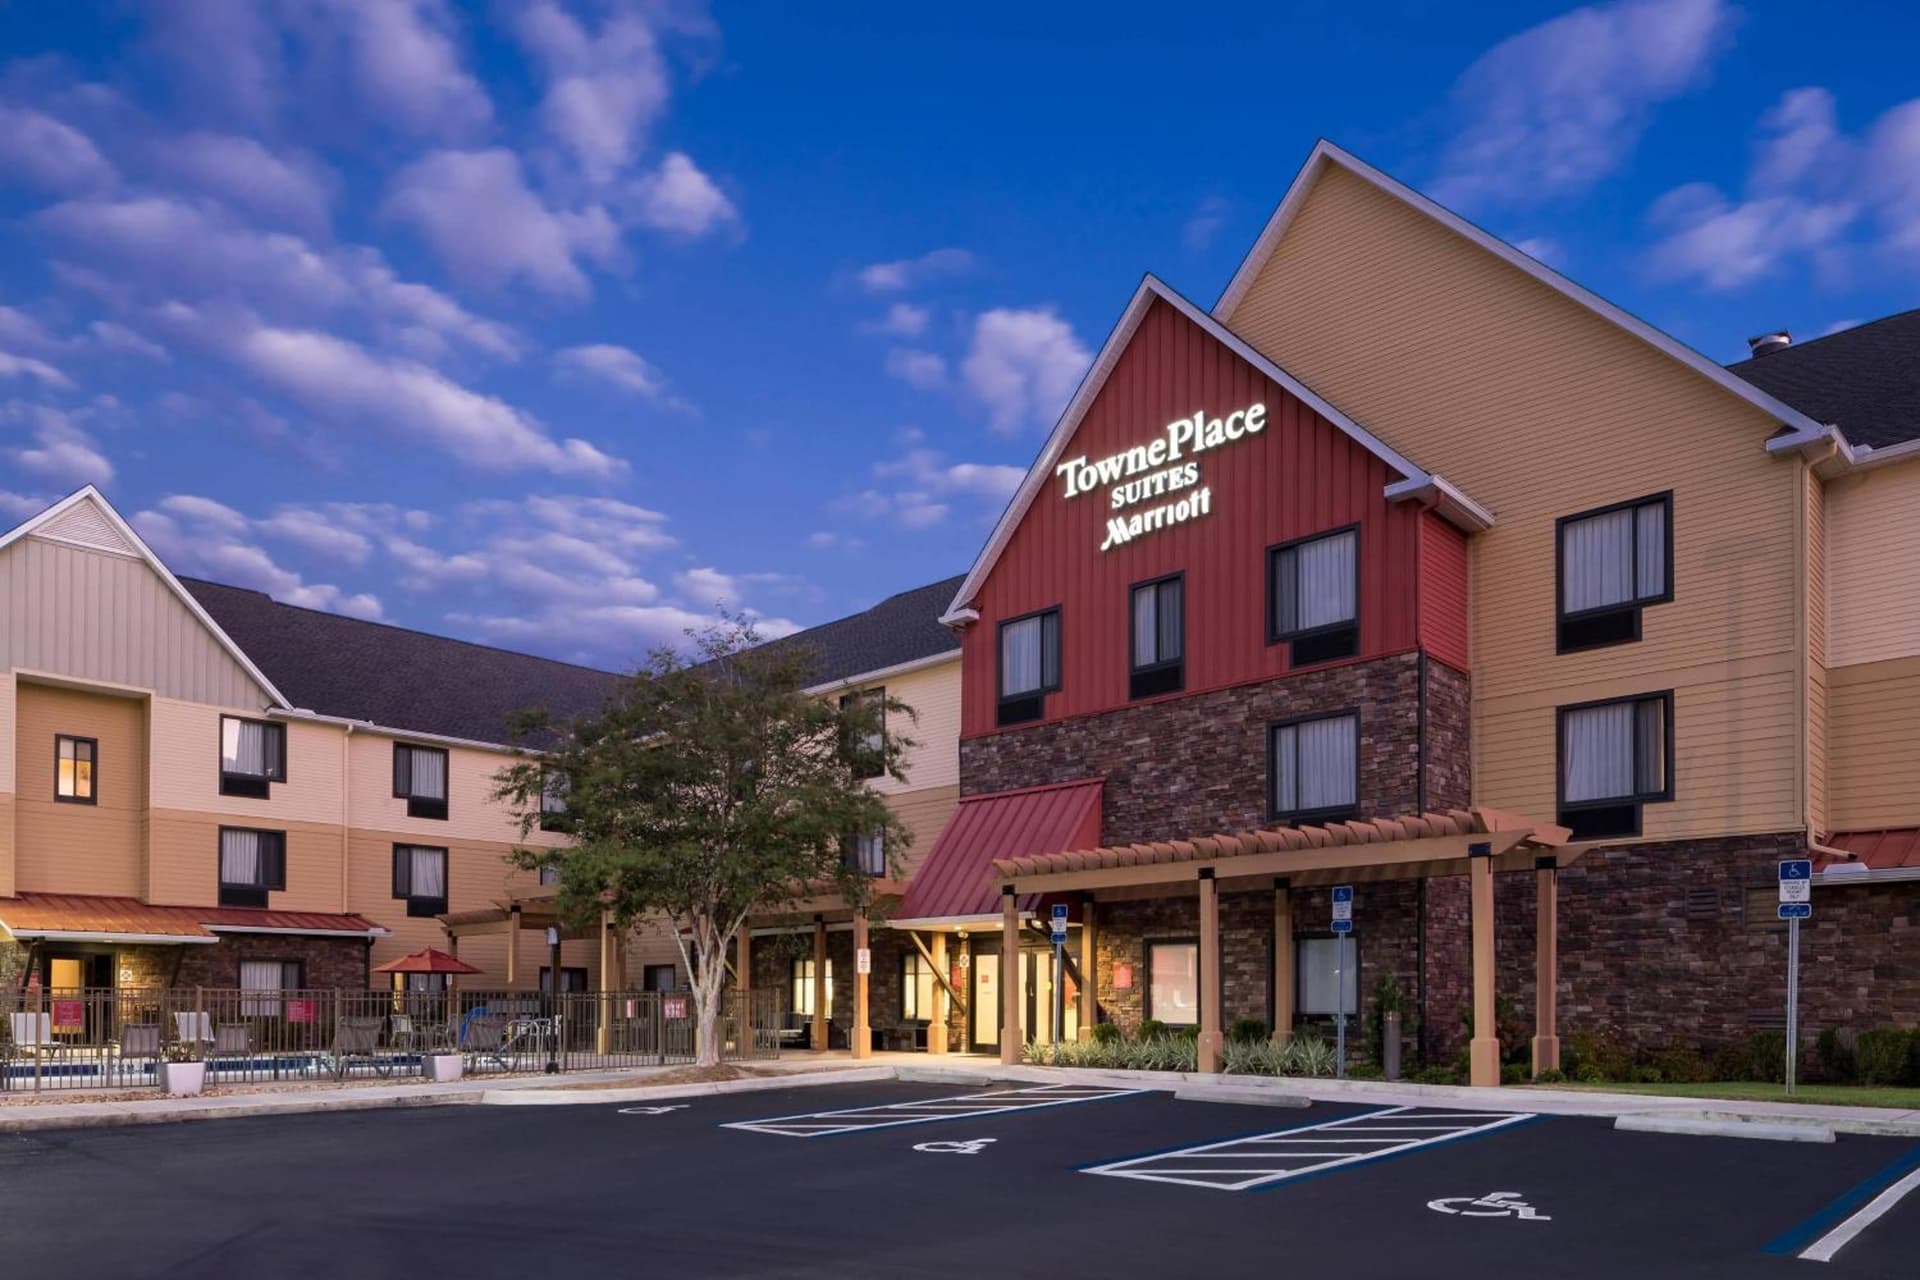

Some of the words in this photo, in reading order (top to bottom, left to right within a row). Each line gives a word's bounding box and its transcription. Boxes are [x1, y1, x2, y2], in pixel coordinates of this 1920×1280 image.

[1057, 403, 1266, 498] TownePlace
[1111, 462, 1199, 509] SUITES
[1101, 487, 1211, 551] Marriott
